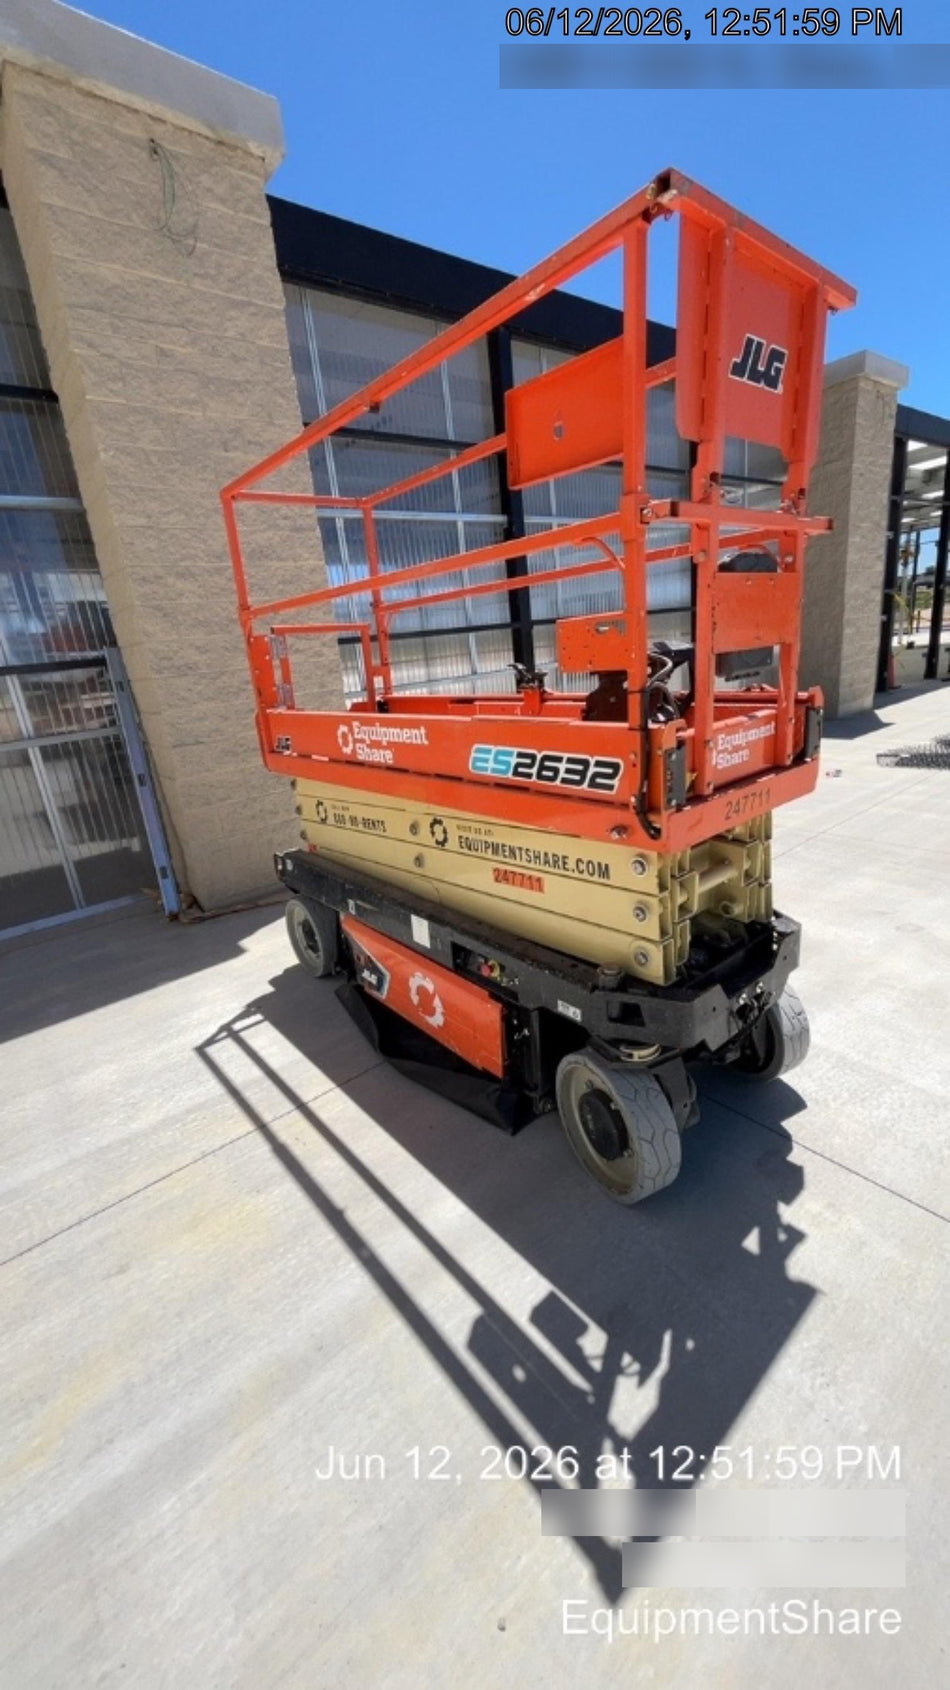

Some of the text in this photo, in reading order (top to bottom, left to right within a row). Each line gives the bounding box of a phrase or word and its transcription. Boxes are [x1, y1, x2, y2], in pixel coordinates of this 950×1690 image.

[729, 335, 788, 393] JLG
[353, 721, 428, 745] Equipment
[717, 721, 776, 749] Equipment
[355, 743, 394, 763] Share
[471, 745, 622, 792] ES2632
[725, 788, 771, 820] 247711
[458, 835, 610, 880] EQUIPMENTSHARE.COM
[493, 867, 544, 893] 247711
